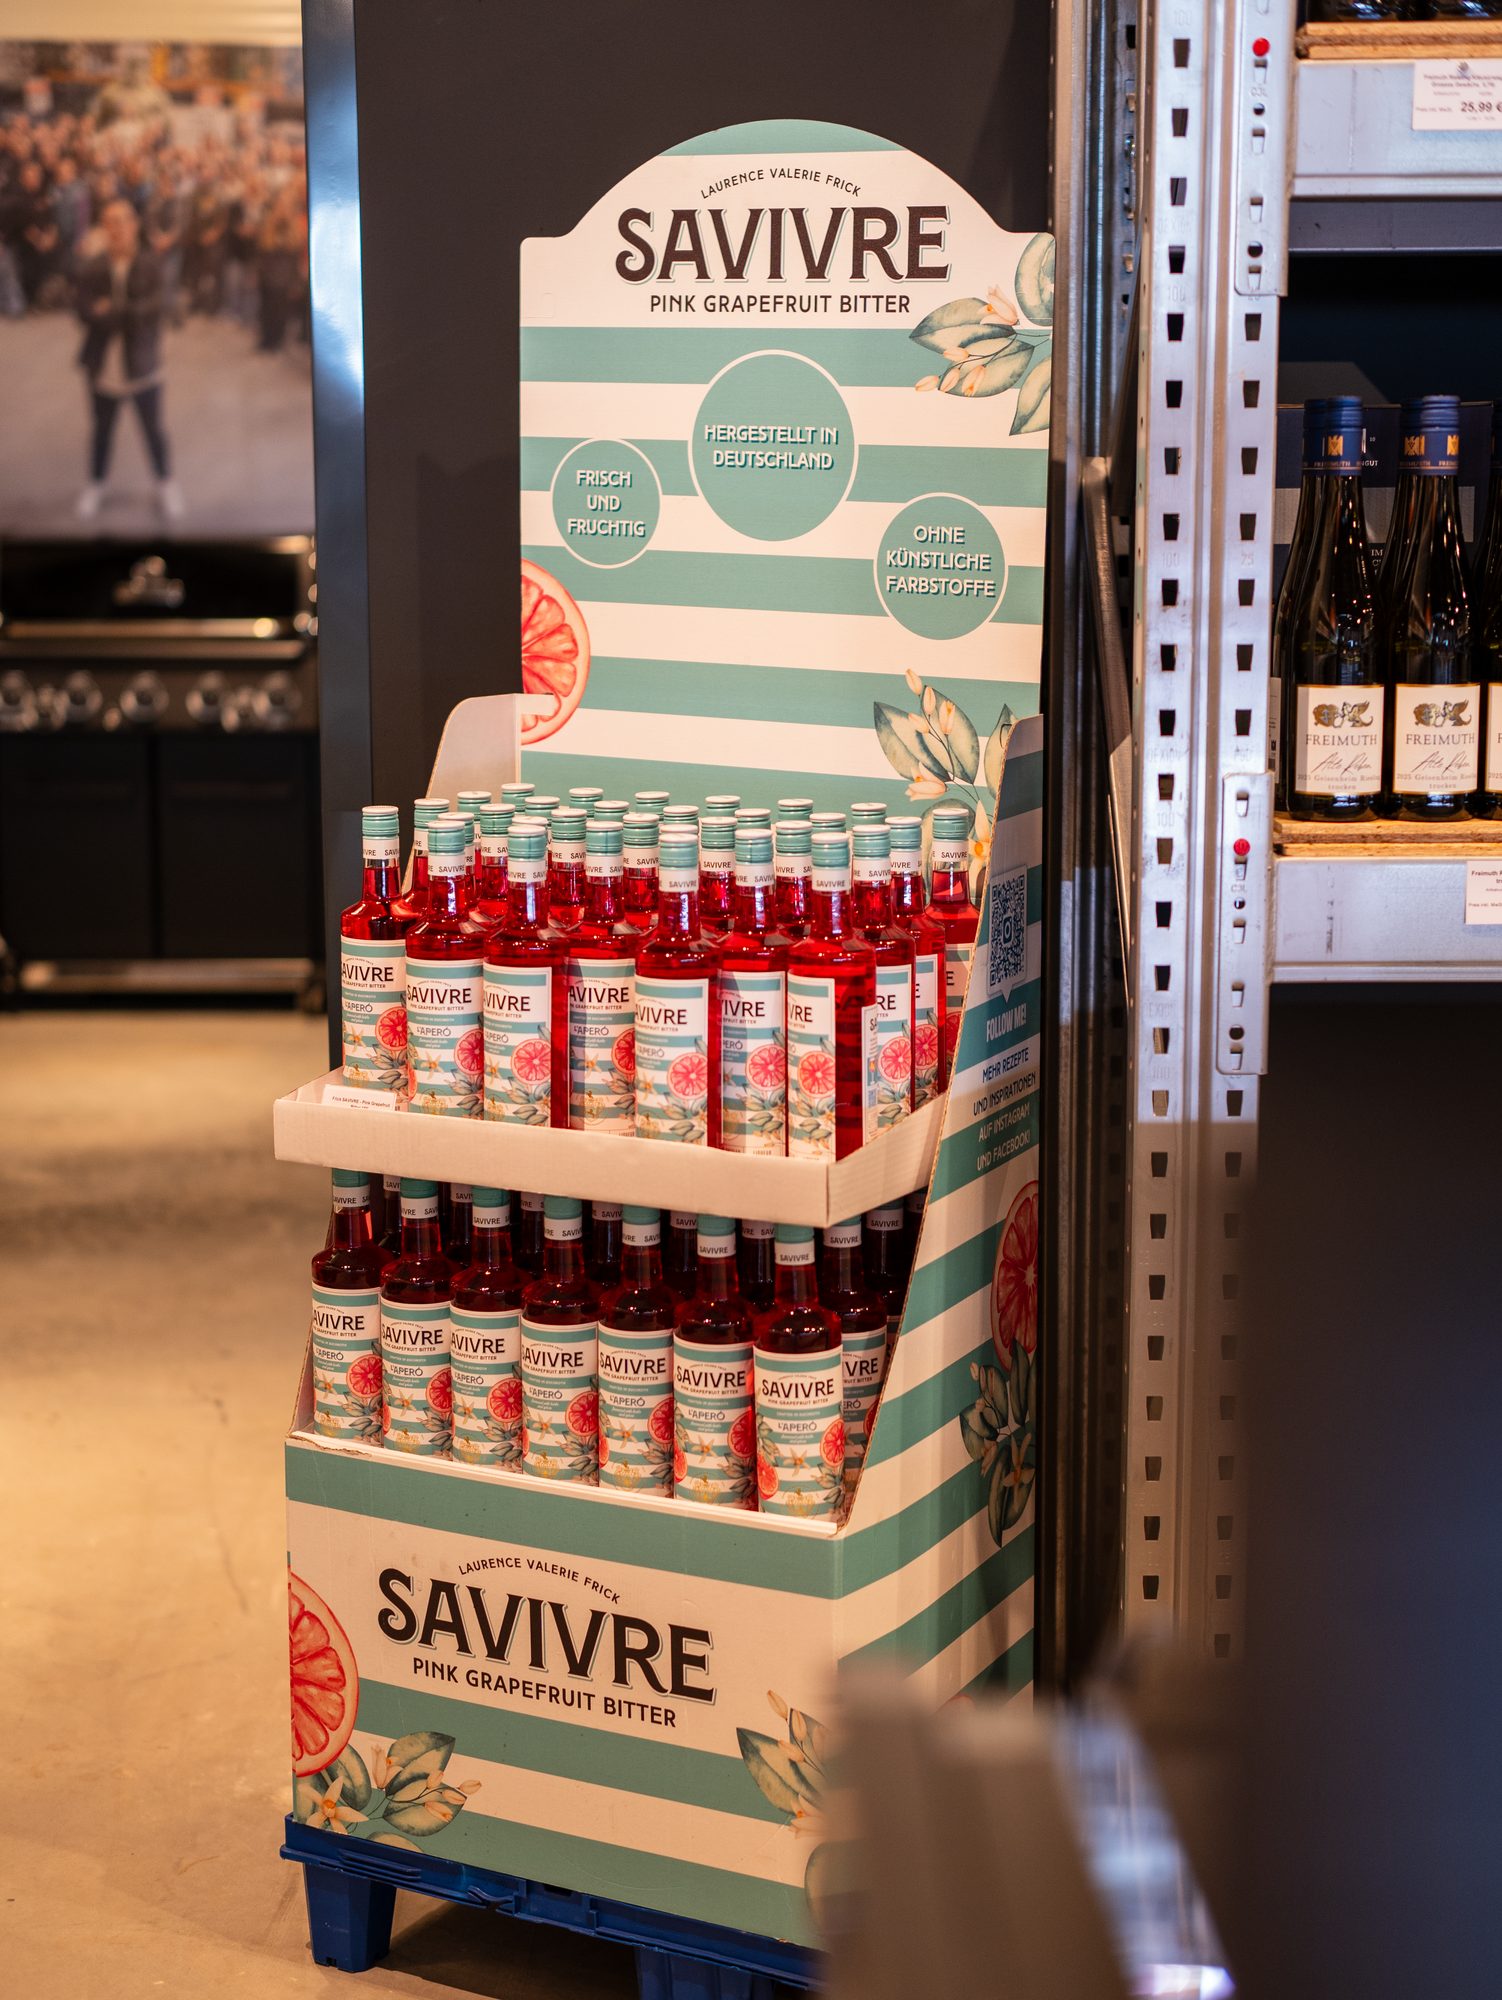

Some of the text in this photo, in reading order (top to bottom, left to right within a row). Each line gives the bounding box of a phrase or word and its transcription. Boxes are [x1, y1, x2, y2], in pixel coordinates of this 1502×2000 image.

[700, 167, 862, 200] LAURENCE VALERIE FRICK
[615, 204, 952, 284] SAVIVRE
[650, 294, 911, 314] PINK GRAPEFRUIT BITTER
[704, 424, 839, 445] HERGESTELLT IN
[712, 451, 835, 471] DEUTSCHLAND
[576, 470, 632, 488] FRISCH
[586, 495, 622, 513] UND
[567, 519, 647, 538] FRUCHTIG
[913, 525, 965, 545] OHNE
[886, 547, 992, 572] KÜNSTLICHE
[885, 575, 996, 598] FARBSTOFFE
[1306, 734, 1377, 746] FREIMUTH
[1406, 733, 1475, 745] FREIMUTH
[816, 880, 845, 888] SAVIVRE
[341, 963, 394, 982] AVIVRE
[407, 984, 472, 1004] SAVIVRE
[569, 987, 629, 1003] AVIVRE
[986, 1003, 1026, 1043] FOLLOW ME!
[983, 1047, 1029, 1083] MEHR REZEPTE
[973, 1072, 1036, 1116] UND INSPIRATIONEN
[979, 1103, 1030, 1143] AUF INSTAGRAM
[977, 1152, 991, 1171] UND
[473, 1217, 500, 1225] SAVIVRE
[676, 1218, 696, 1226] SAVIV
[871, 1219, 899, 1227] SAVIVRE
[830, 1236, 859, 1244] SAVIVRE
[314, 1310, 365, 1330] AVIVRE
[451, 1332, 505, 1354] AVIVRE
[600, 1352, 666, 1375] SAVIVRE
[677, 1365, 746, 1388] SAVIVRE
[762, 1378, 834, 1399] SAVIVRE
[459, 1556, 621, 1605] LAURENCE VALERIE FRICK
[377, 1567, 718, 1705] SAVIVRE
[413, 1657, 677, 1729] PINK GRAPEFRUIT BITTER
